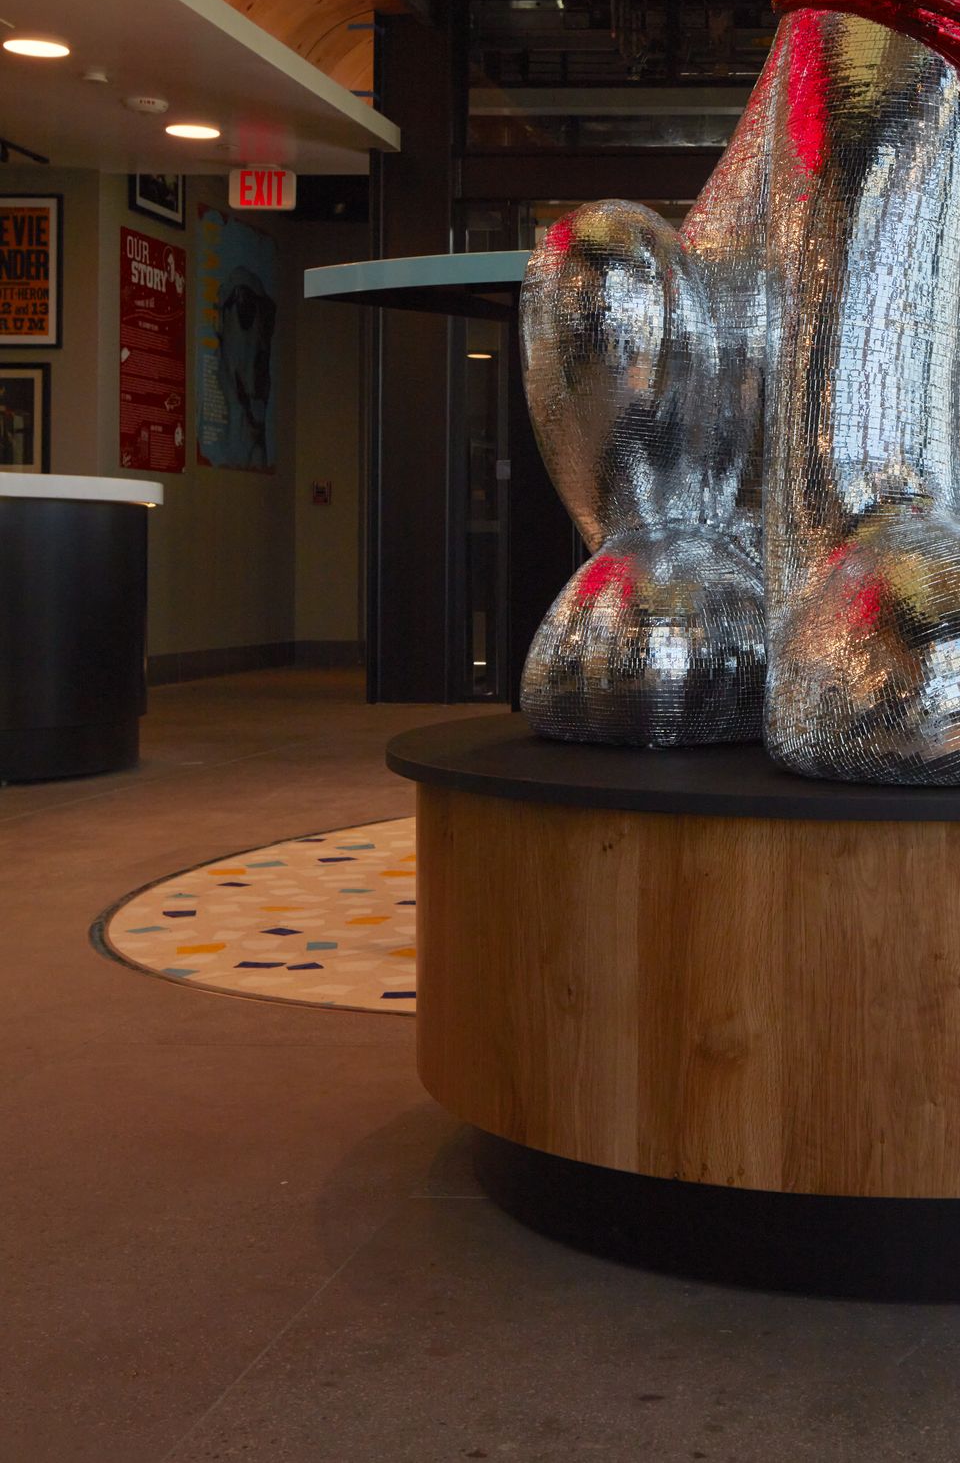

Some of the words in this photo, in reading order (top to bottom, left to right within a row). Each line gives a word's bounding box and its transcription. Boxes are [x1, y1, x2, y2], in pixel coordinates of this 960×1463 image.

[239, 170, 286, 207] EXIT
[126, 235, 150, 264] OUR
[131, 260, 168, 294] STORY
